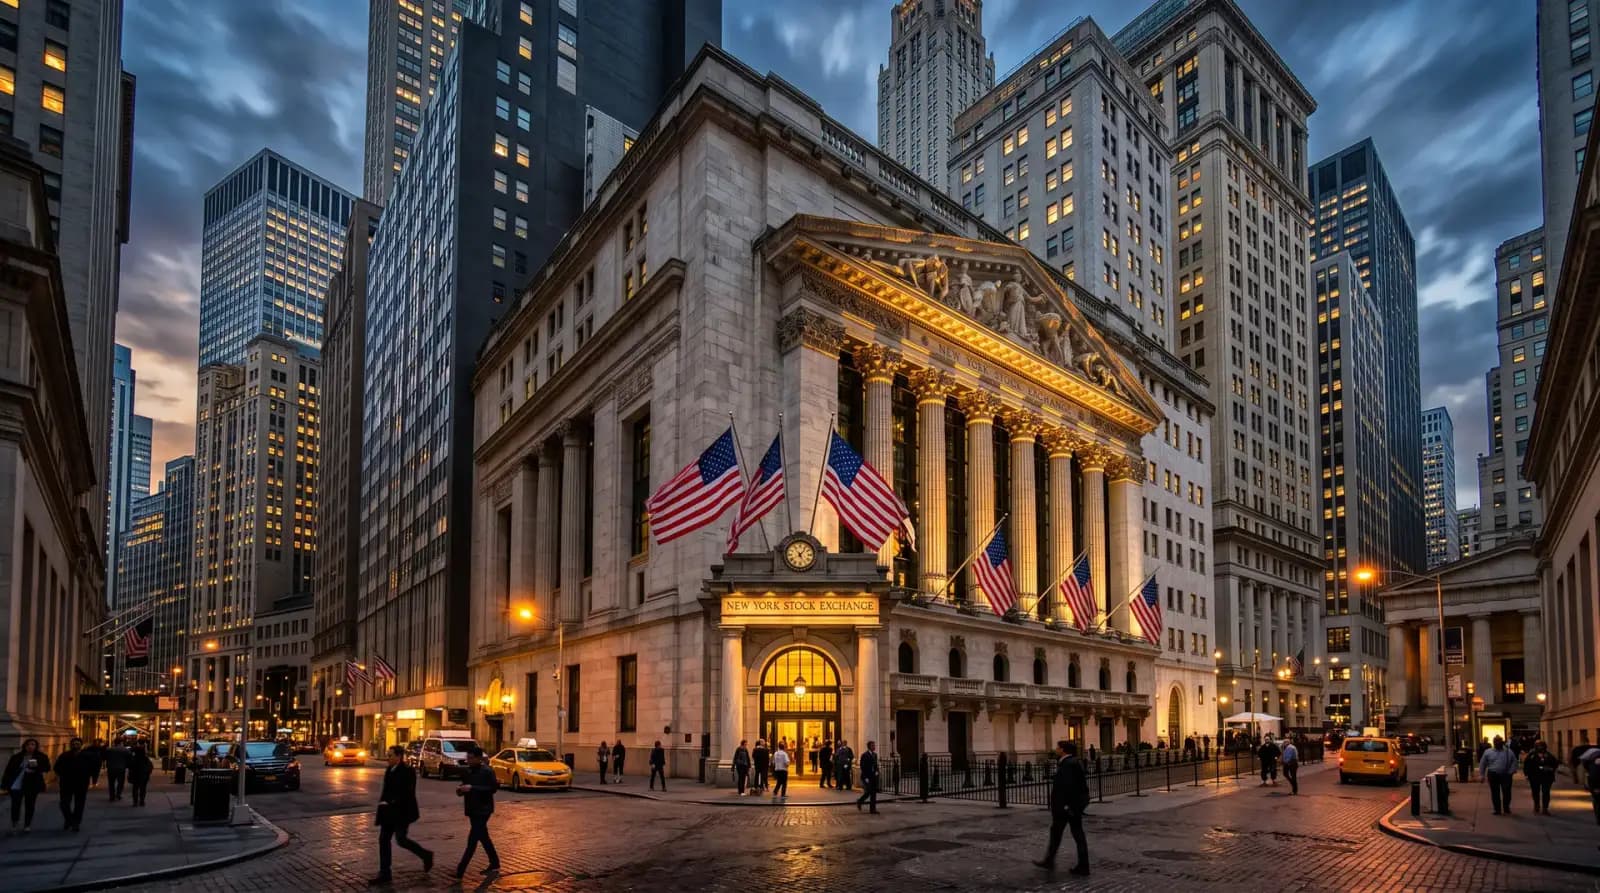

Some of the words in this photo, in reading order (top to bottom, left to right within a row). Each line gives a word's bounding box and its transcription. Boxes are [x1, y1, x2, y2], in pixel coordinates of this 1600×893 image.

[938, 343, 961, 361] NEW
[727, 601, 750, 611] NEW
[753, 601, 780, 611] YORK
[784, 601, 816, 611] STOCK
[820, 601, 874, 611] EXCHANGE
